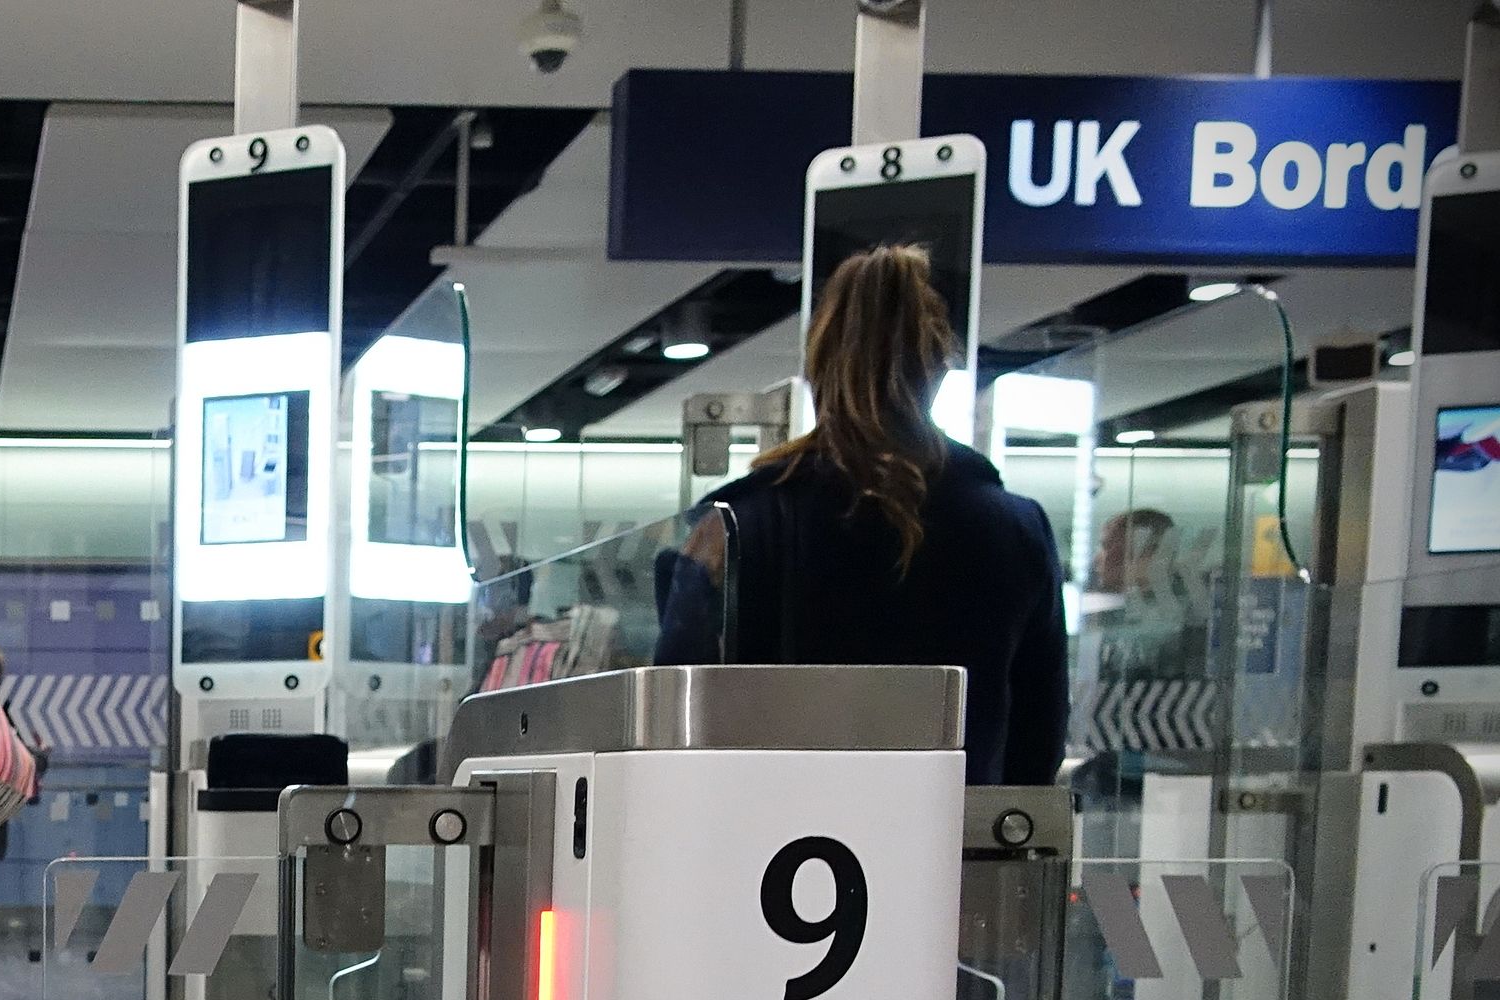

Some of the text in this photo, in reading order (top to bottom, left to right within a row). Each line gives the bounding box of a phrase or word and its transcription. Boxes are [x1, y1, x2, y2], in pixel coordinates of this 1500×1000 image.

[249, 137, 268, 172] 9
[880, 147, 902, 180] 8
[1009, 120, 1459, 210] UK Bord
